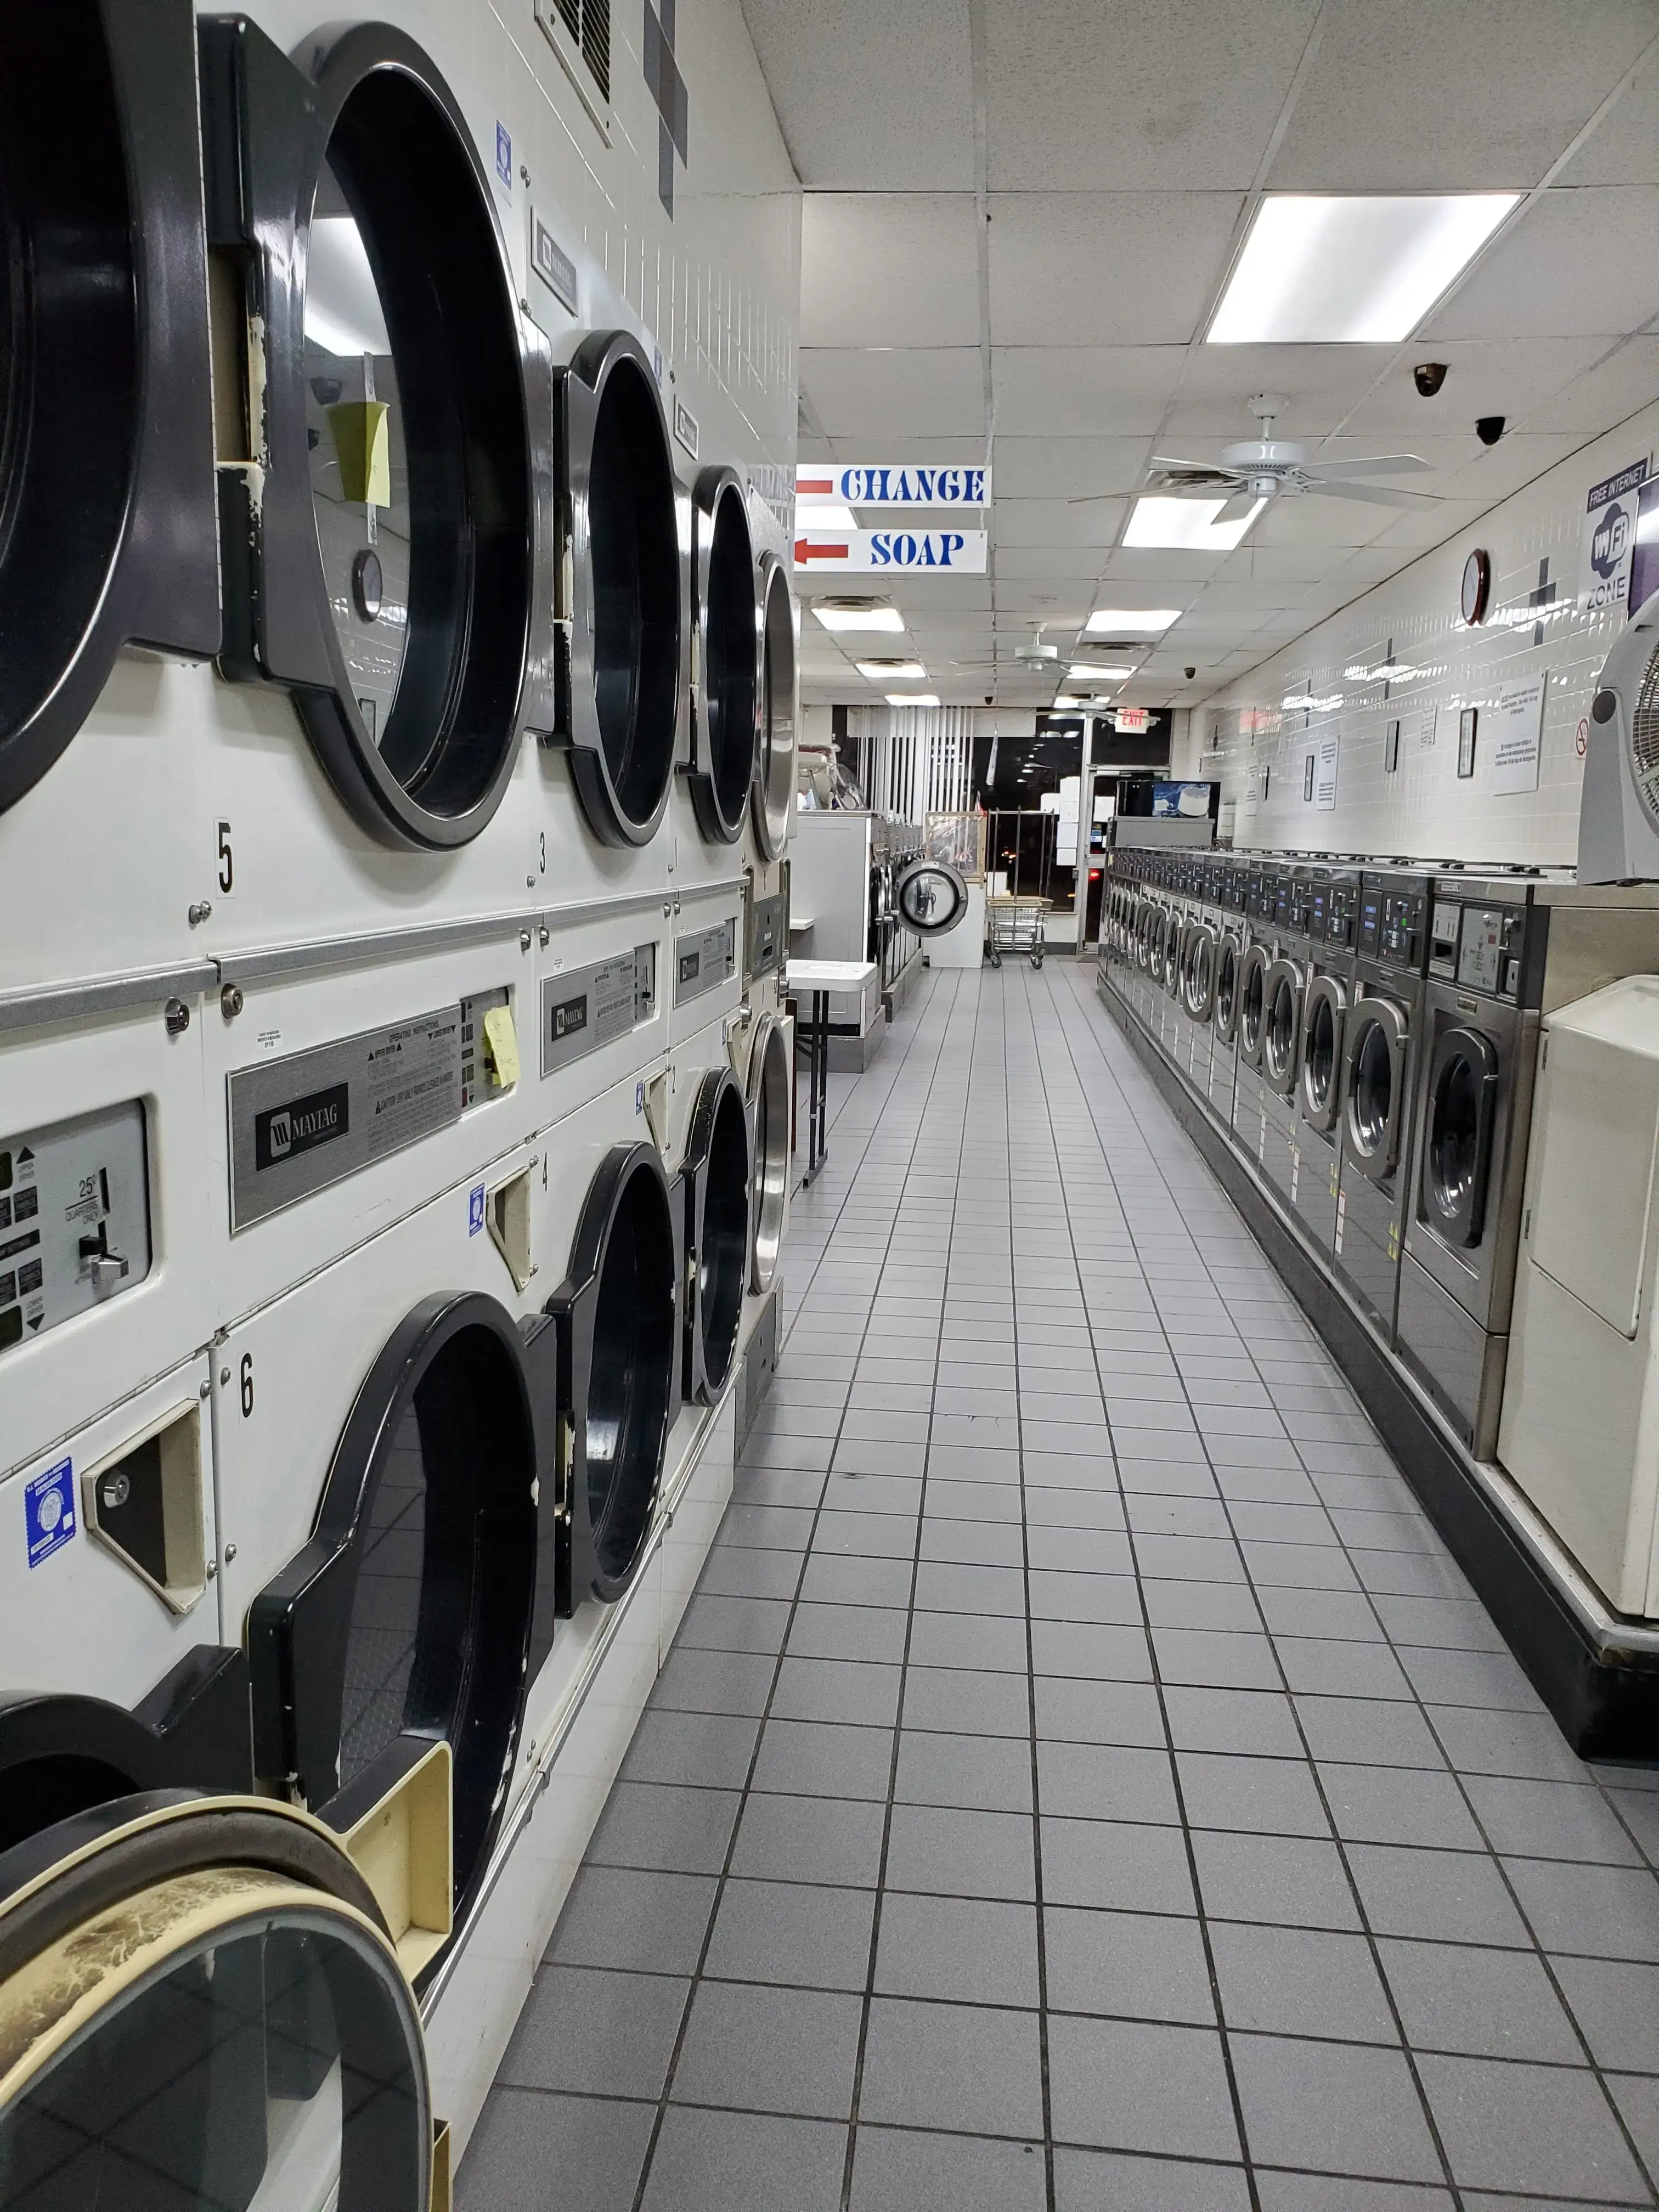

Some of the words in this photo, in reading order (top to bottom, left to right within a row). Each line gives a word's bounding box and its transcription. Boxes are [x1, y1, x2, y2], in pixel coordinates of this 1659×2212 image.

[840, 469, 984, 501] CHANGE
[1589, 484, 1608, 509] FREE
[1608, 464, 1645, 497] INTERNET
[871, 534, 964, 566] SOAP
[1587, 575, 1627, 611] ZONE
[1122, 710, 1144, 727] EXIT
[218, 822, 233, 894] 5
[539, 831, 546, 874] 3
[565, 1006, 583, 1026] MAYTAG
[672, 1065, 676, 1094] 2
[292, 1103, 338, 1141] MAYTAG
[542, 1152, 548, 1192] 4
[65, 1199, 99, 1222] QUARTERS
[240, 1352, 254, 1418] 6
